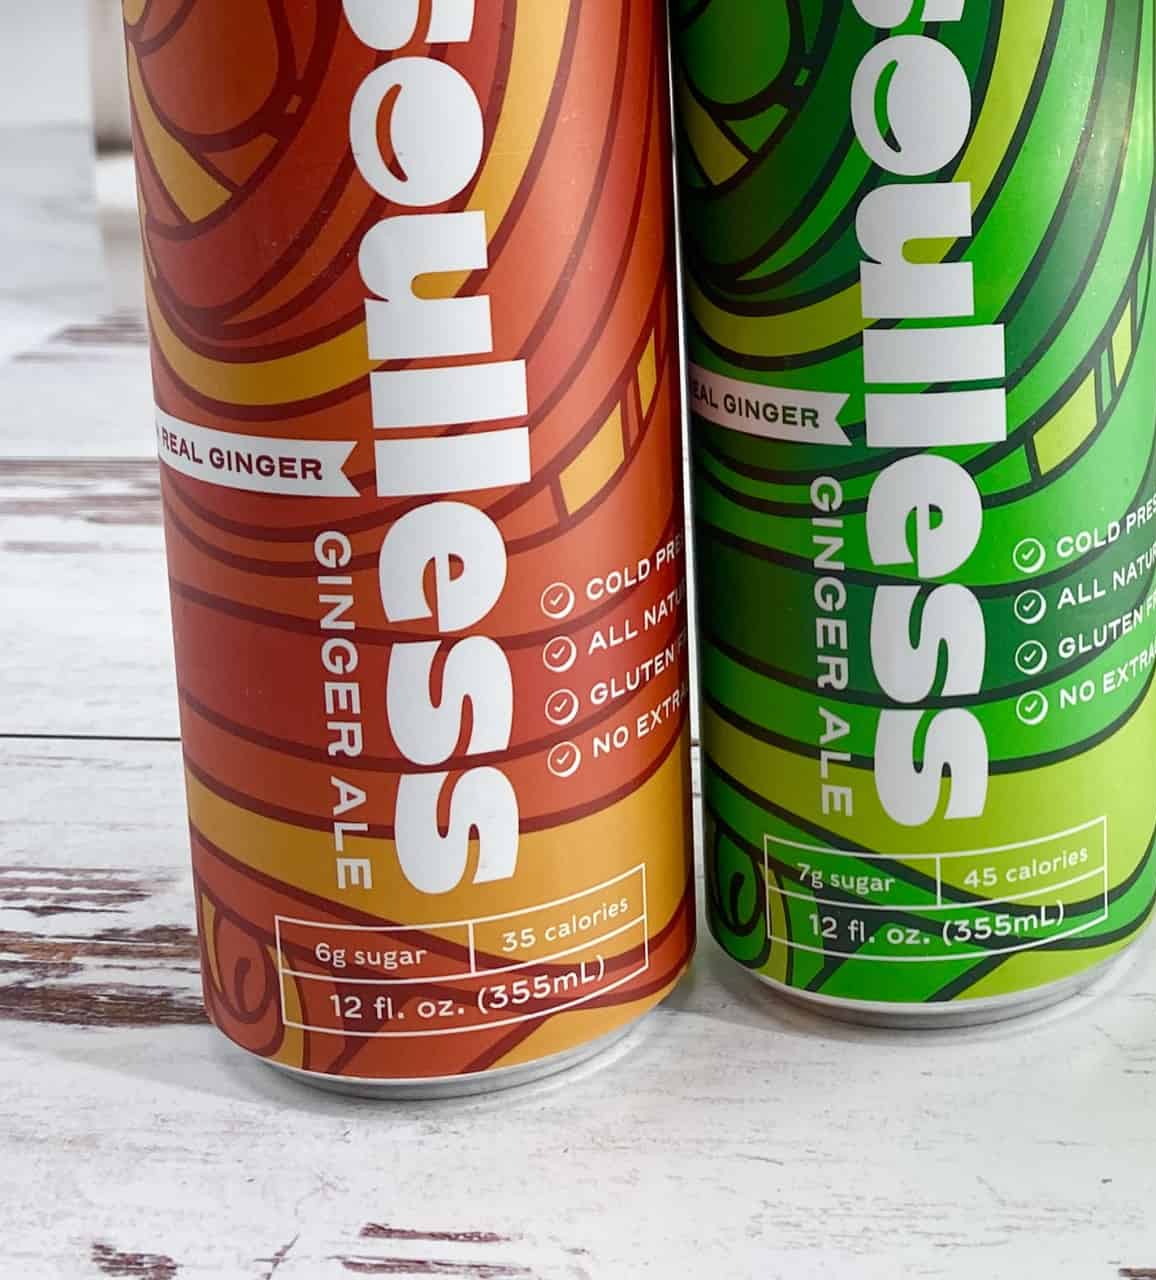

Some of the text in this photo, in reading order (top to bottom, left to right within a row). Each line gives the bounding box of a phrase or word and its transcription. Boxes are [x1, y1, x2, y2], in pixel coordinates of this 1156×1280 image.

[690, 376, 820, 428] EAL GINGER
[161, 426, 323, 481] REAL GINGER
[1056, 521, 1121, 558] COLD
[586, 558, 651, 601] COLD
[1057, 578, 1106, 609] ALL
[588, 619, 639, 655] ALL
[809, 475, 853, 817] GINGER ALE
[1058, 604, 1144, 659] GLUTEN
[590, 643, 675, 706] GLUTEN
[1060, 680, 1095, 709] NO
[313, 531, 373, 890] GINGER ALE
[592, 725, 630, 759] NO
[798, 863, 896, 895] 7g sugar
[963, 846, 1089, 889] 45 calories
[501, 897, 629, 953] 35 calories
[808, 900, 1065, 945] 12 fl. oz. (355mL)
[315, 942, 428, 970] 6g sugar
[329, 954, 606, 1020] 12 fl. oz. (355mL)
